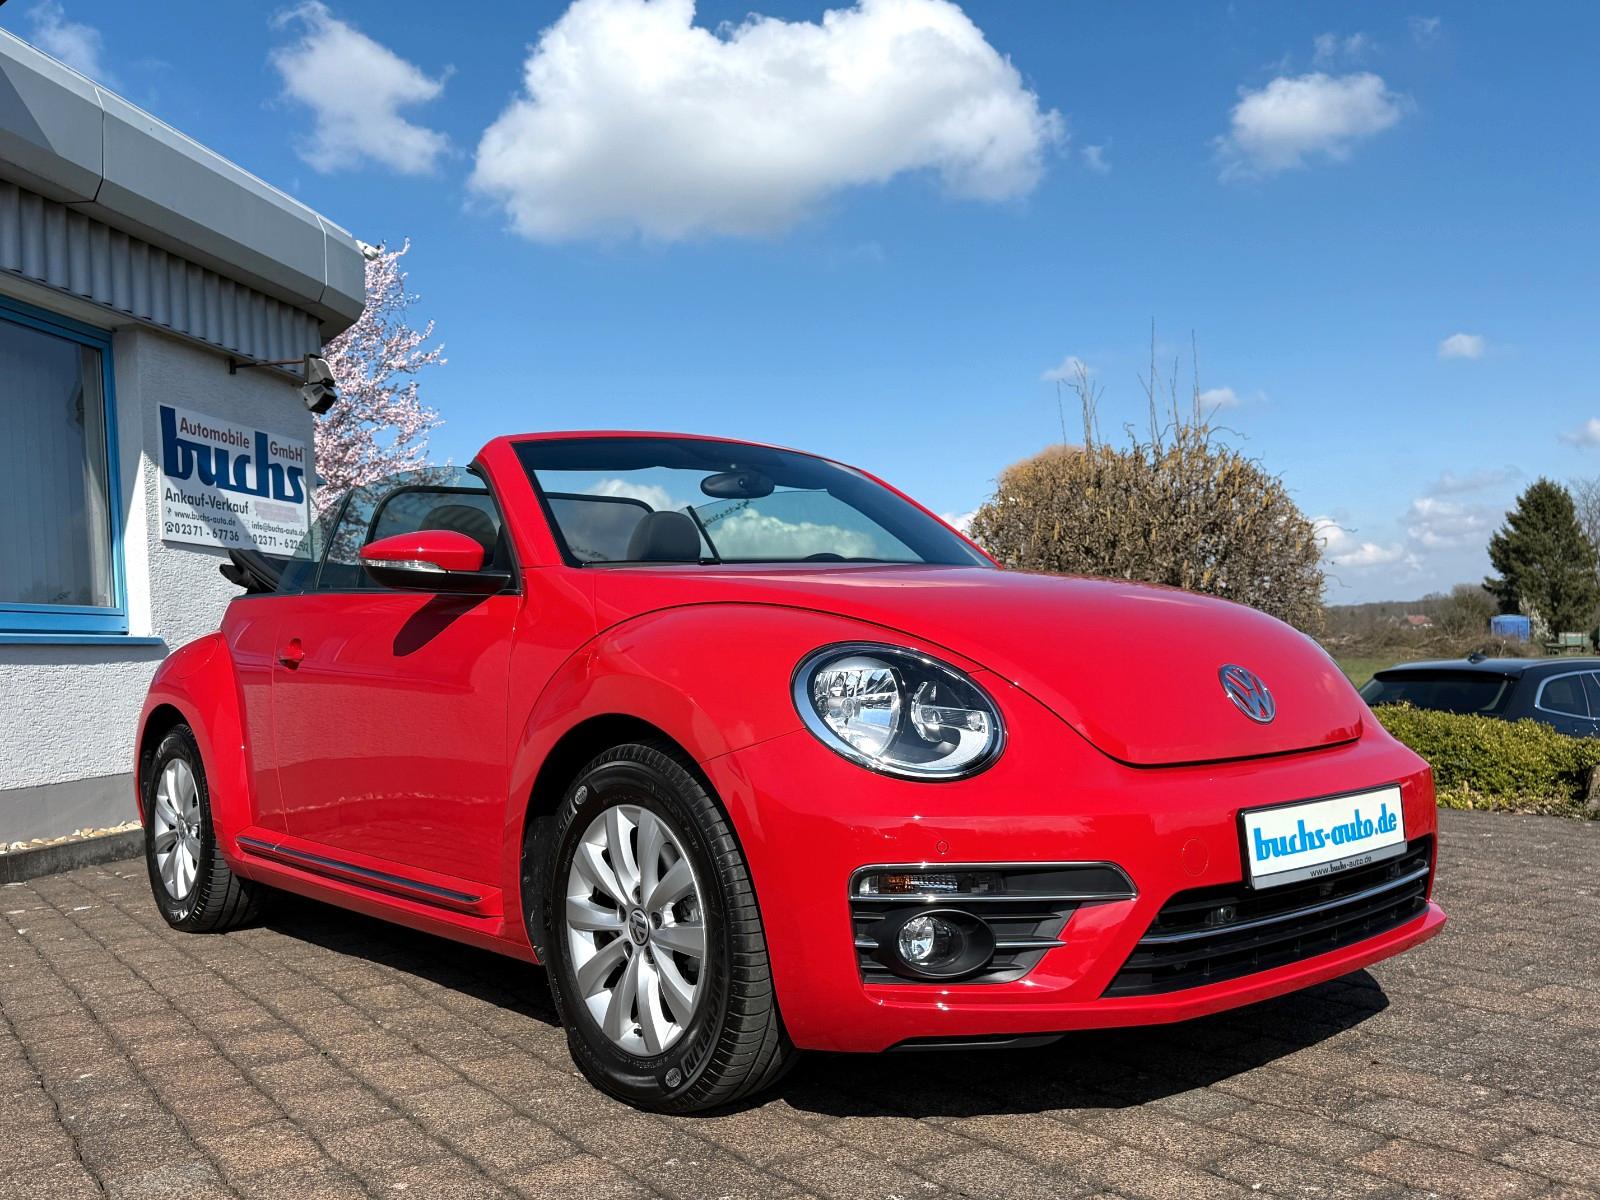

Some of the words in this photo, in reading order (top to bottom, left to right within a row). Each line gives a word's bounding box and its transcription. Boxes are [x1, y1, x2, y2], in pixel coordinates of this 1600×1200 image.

[180, 417, 250, 449] Automobile
[270, 441, 303, 463] GmbH
[160, 405, 303, 504] buchs
[165, 488, 249, 514] Ankauf-Verkauf
[174, 511, 236, 526] www.buchs-auto.de
[251, 521, 305, 537] info@buchs-auto.de
[212, 528, 240, 542] 67736
[1253, 803, 1397, 861] buchs-auto.de
[1309, 856, 1372, 877] www.buchs-auto.de
